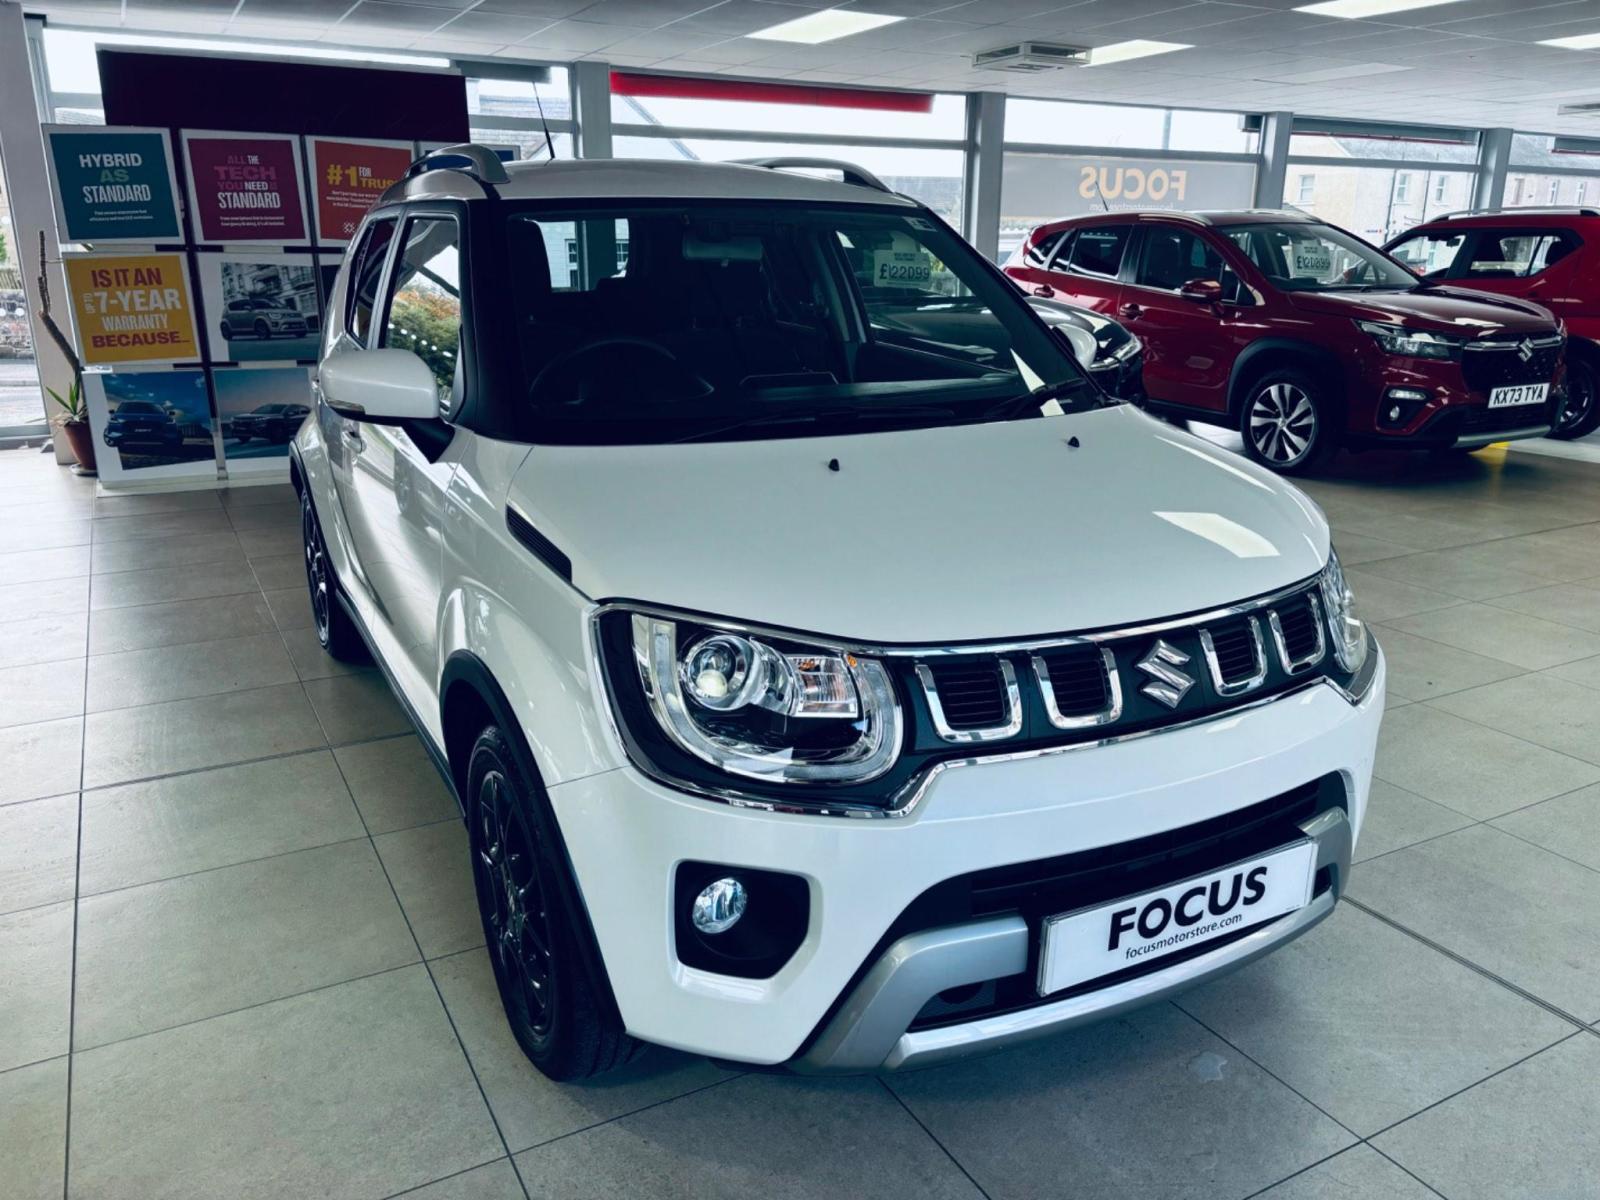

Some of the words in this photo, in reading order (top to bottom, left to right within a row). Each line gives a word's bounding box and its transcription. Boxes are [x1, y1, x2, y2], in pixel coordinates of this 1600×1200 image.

[79, 153, 142, 168] HYBRID
[227, 155, 246, 165] ALL
[247, 154, 260, 165] THE
[100, 169, 130, 183] AS
[214, 166, 277, 181] TECH
[326, 164, 358, 187] #1
[359, 167, 372, 177] FOR
[217, 181, 243, 190] YOU
[244, 181, 269, 191] NEED
[360, 178, 396, 190] TRUS
[82, 184, 152, 204] STANDARD
[217, 191, 281, 209] STANDARD
[91, 270, 112, 289] IS
[114, 268, 131, 287] IT
[133, 267, 163, 286] AN
[94, 288, 182, 313] 7-YEAR
[101, 314, 168, 331] WARRANTY
[1493, 387, 1523, 405] KX73
[1524, 385, 1544, 402] TYA
[1108, 866, 1268, 952] FOCUS
[1125, 914, 1242, 959] focusmotorstore.com
